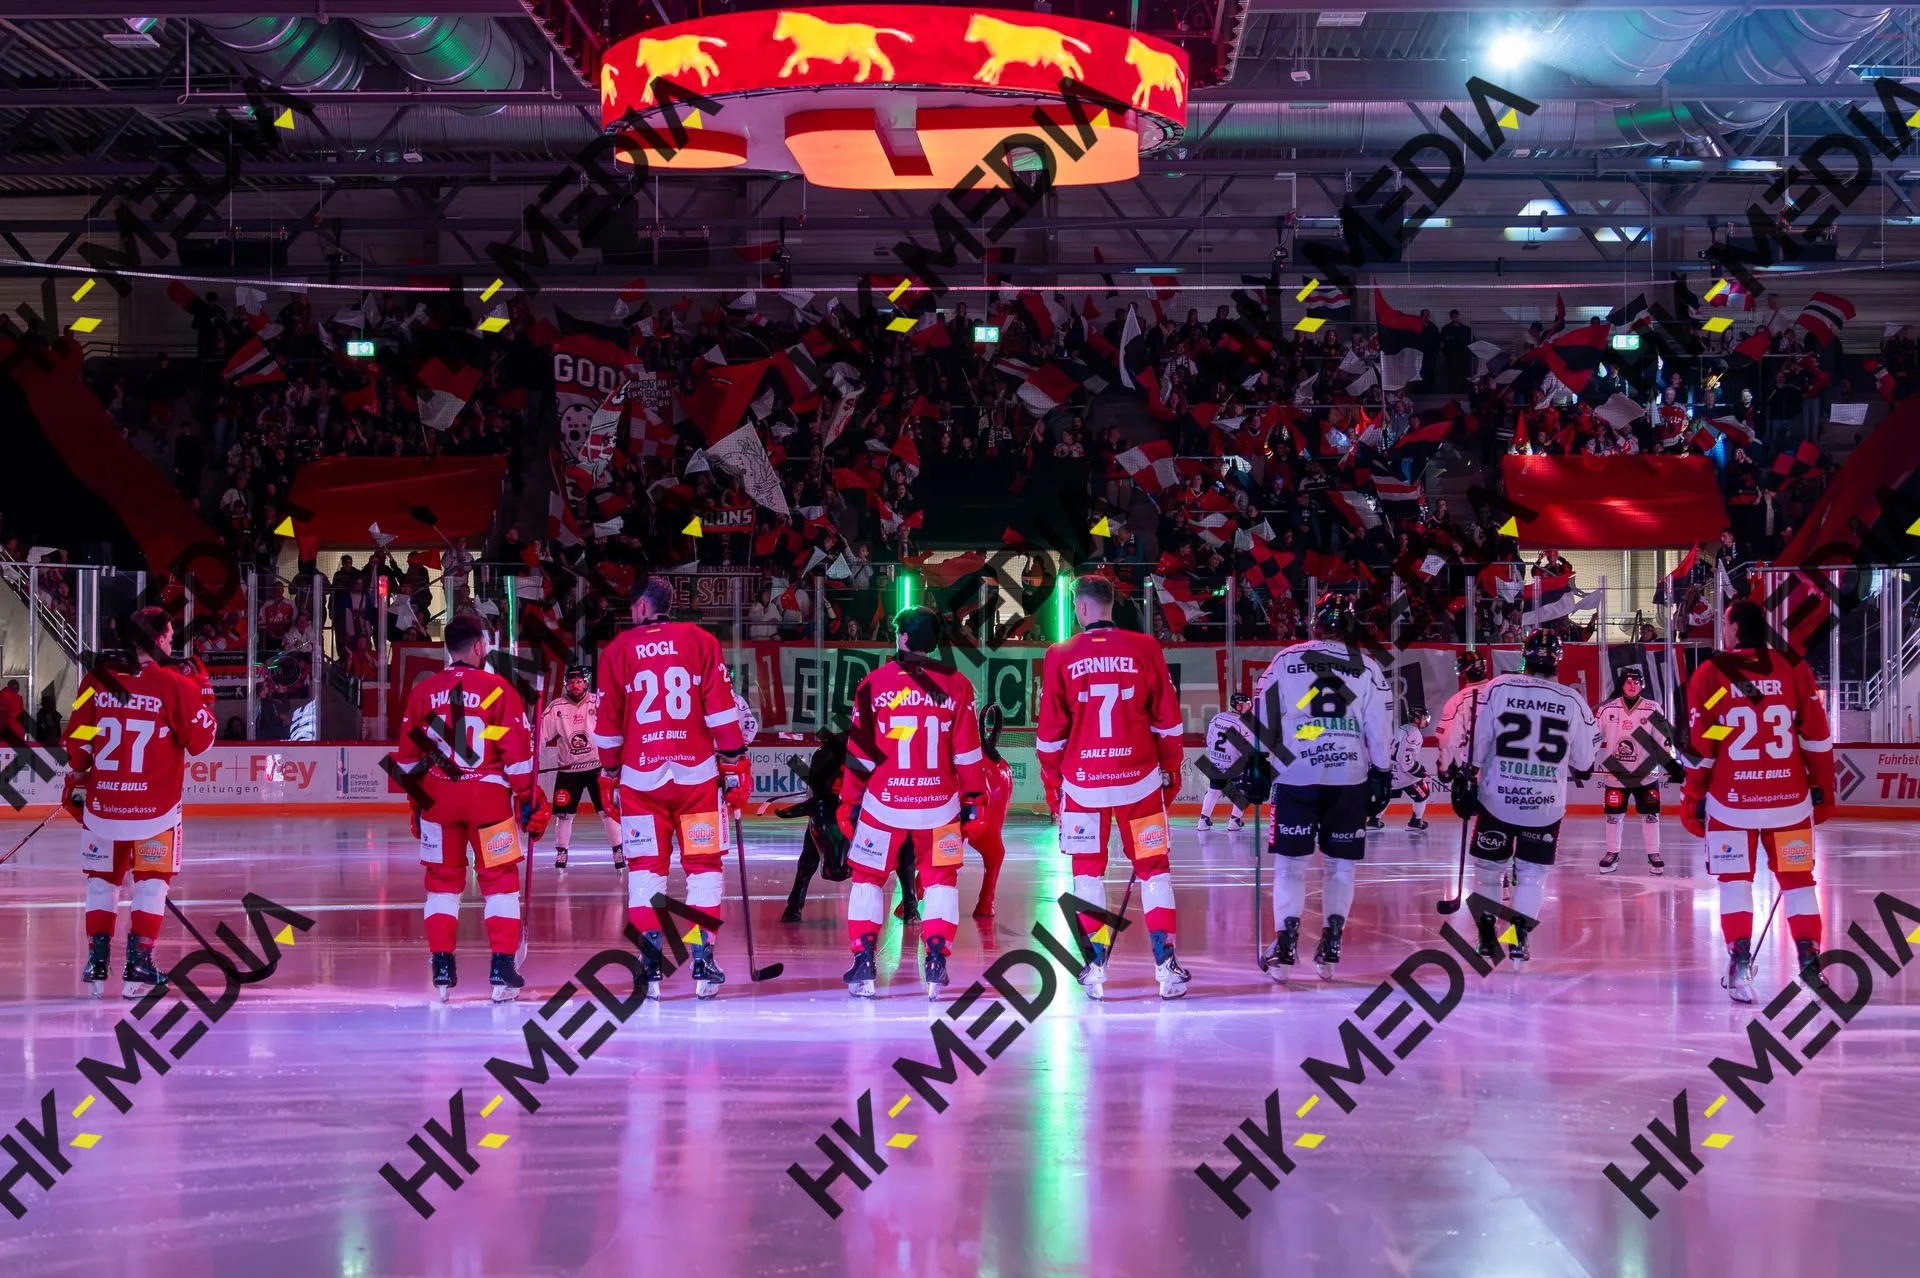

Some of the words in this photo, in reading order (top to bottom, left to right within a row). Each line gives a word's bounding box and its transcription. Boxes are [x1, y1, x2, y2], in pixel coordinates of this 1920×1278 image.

[635, 640, 678, 660] ROGL
[1067, 656, 1139, 679] ZERNIKEL
[1287, 662, 1360, 679] GERSTUNG
[633, 666, 692, 725] 28
[1310, 676, 1349, 718] 6
[1730, 679, 1783, 699] NEHER
[93, 691, 163, 714] SCHAEFER
[1089, 683, 1119, 738] 7
[1506, 697, 1566, 716] KRAMER
[641, 731, 665, 744] SAALE
[665, 729, 687, 741] BULLS
[1496, 712, 1569, 764] 25
[1726, 704, 1794, 761] 23
[94, 717, 157, 773] 27
[889, 715, 940, 769] 71
[1214, 731, 1228, 753] 2
[774, 751, 804, 764] Klotz
[1080, 748, 1106, 759] SAALE
[1107, 746, 1133, 758] BULLS
[1300, 742, 1336, 759] BLACK
[1878, 752, 1920, 765] Fuhrbet
[1310, 752, 1358, 767] DRAGONS
[887, 776, 914, 788] SAALE
[915, 775, 941, 787] BULLS
[1087, 768, 1141, 784] Saalesparkasse
[1733, 769, 1765, 781] SAALE
[1765, 768, 1792, 780] BULLS
[96, 781, 119, 791] SAALE
[120, 781, 148, 792] BULLS
[183, 784, 259, 795] rleitungen
[1497, 785, 1534, 796] BLACK
[1876, 772, 1920, 799] Th
[893, 793, 949, 805] Saalesparkasse
[1504, 795, 1556, 805] DRAGONS
[1741, 791, 1800, 805] Saalesparkasse
[103, 804, 157, 815] Saalesparkasse
[1278, 823, 1311, 836] TecArt
[1477, 831, 1508, 847] TecArt
